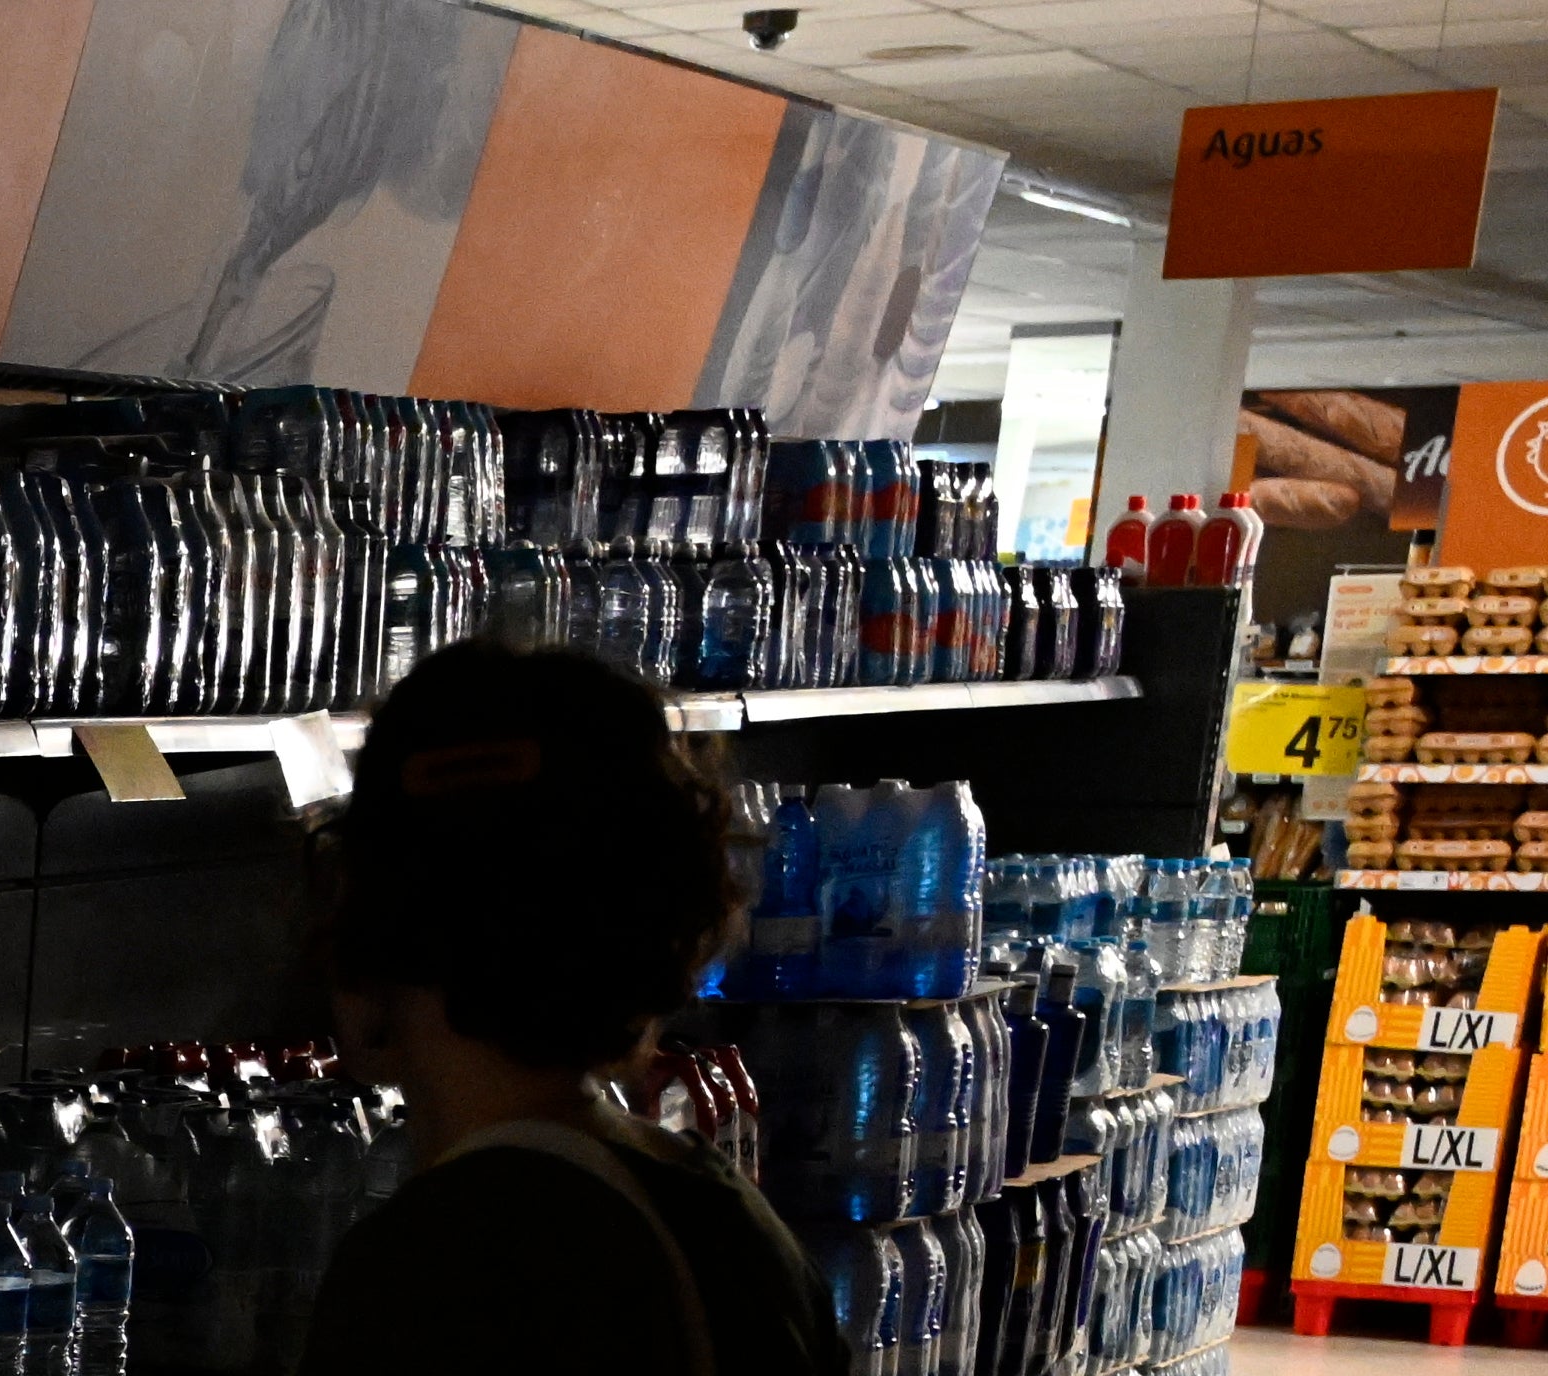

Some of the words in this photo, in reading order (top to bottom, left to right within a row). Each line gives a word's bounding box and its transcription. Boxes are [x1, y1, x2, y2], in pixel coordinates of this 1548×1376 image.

[1202, 128, 1324, 169] Aguas
[1284, 715, 1323, 769] 4
[1327, 717, 1358, 740] 75
[1412, 1127, 1483, 1168] L/XL
[1394, 1247, 1464, 1286] L/XL
